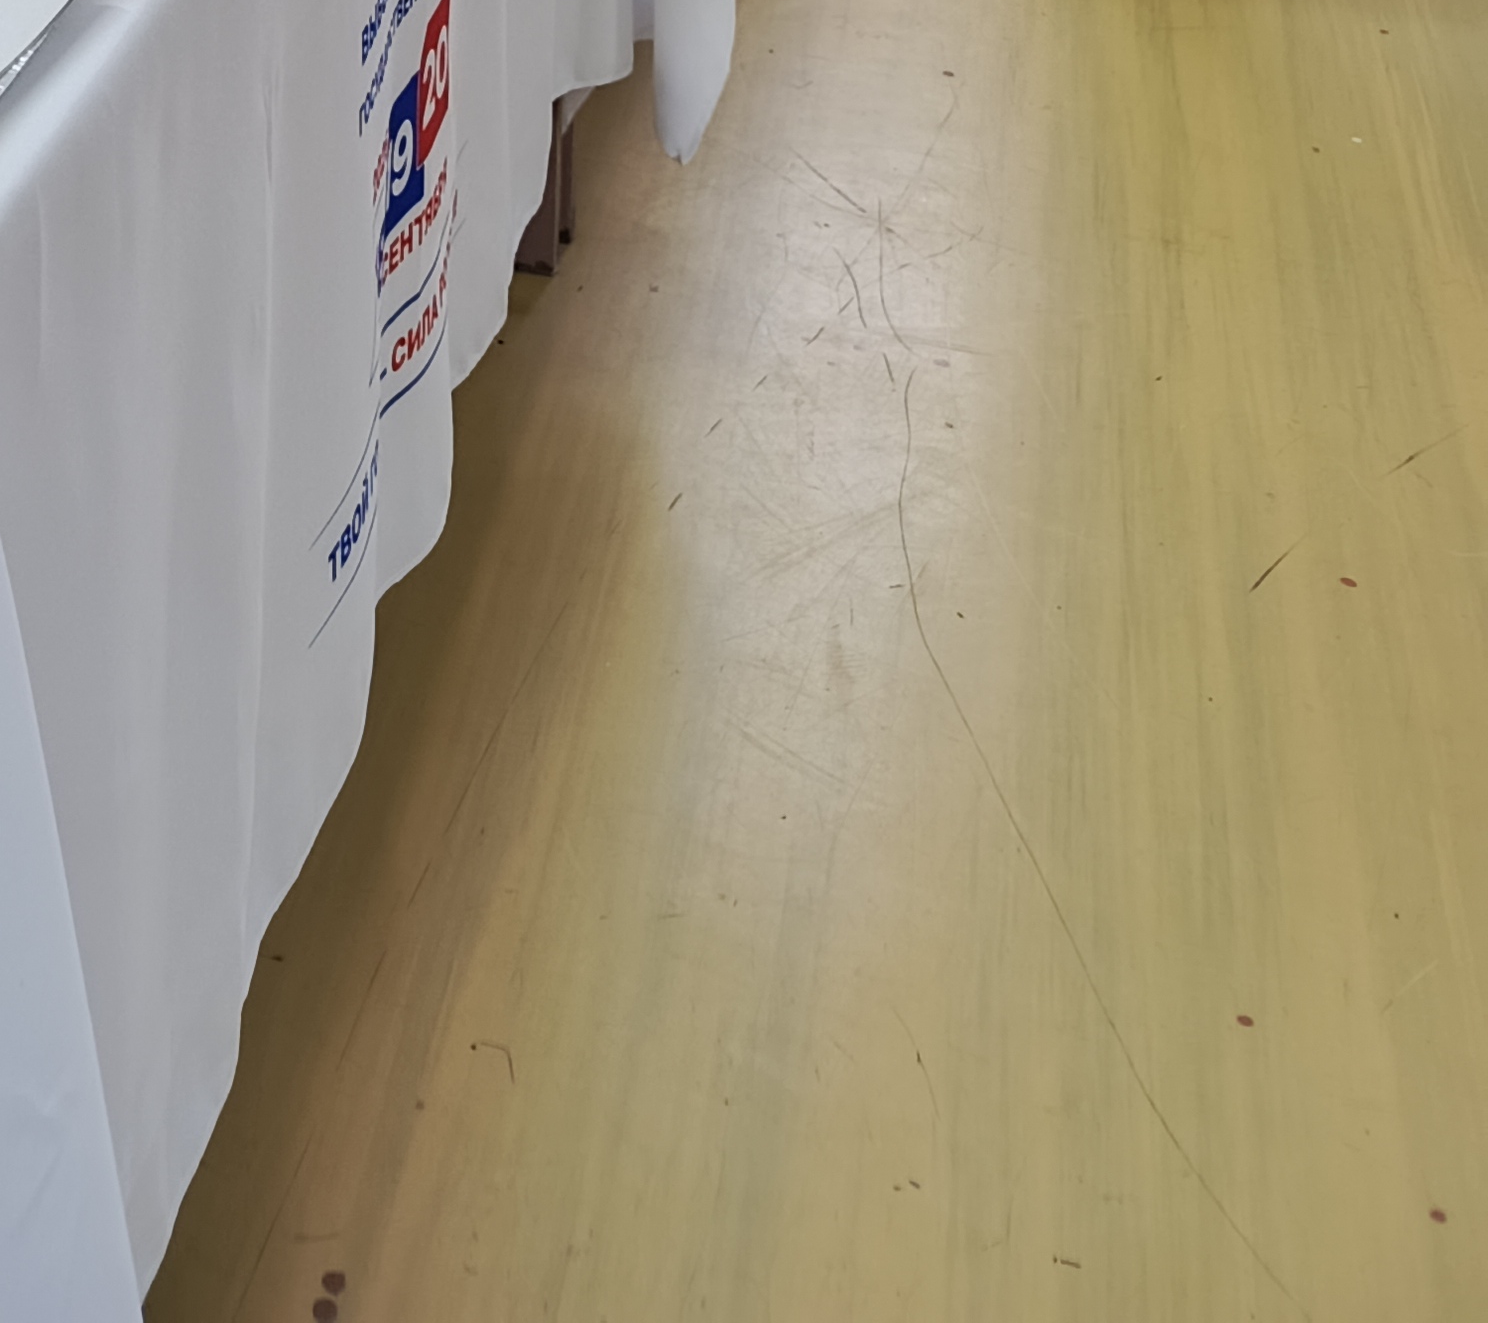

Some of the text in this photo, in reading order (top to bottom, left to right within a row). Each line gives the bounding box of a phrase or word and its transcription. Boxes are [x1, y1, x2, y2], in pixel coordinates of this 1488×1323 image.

[421, 24, 448, 132] 20
[391, 304, 438, 372] СИЛА
[328, 472, 369, 582] ТВОЙ
